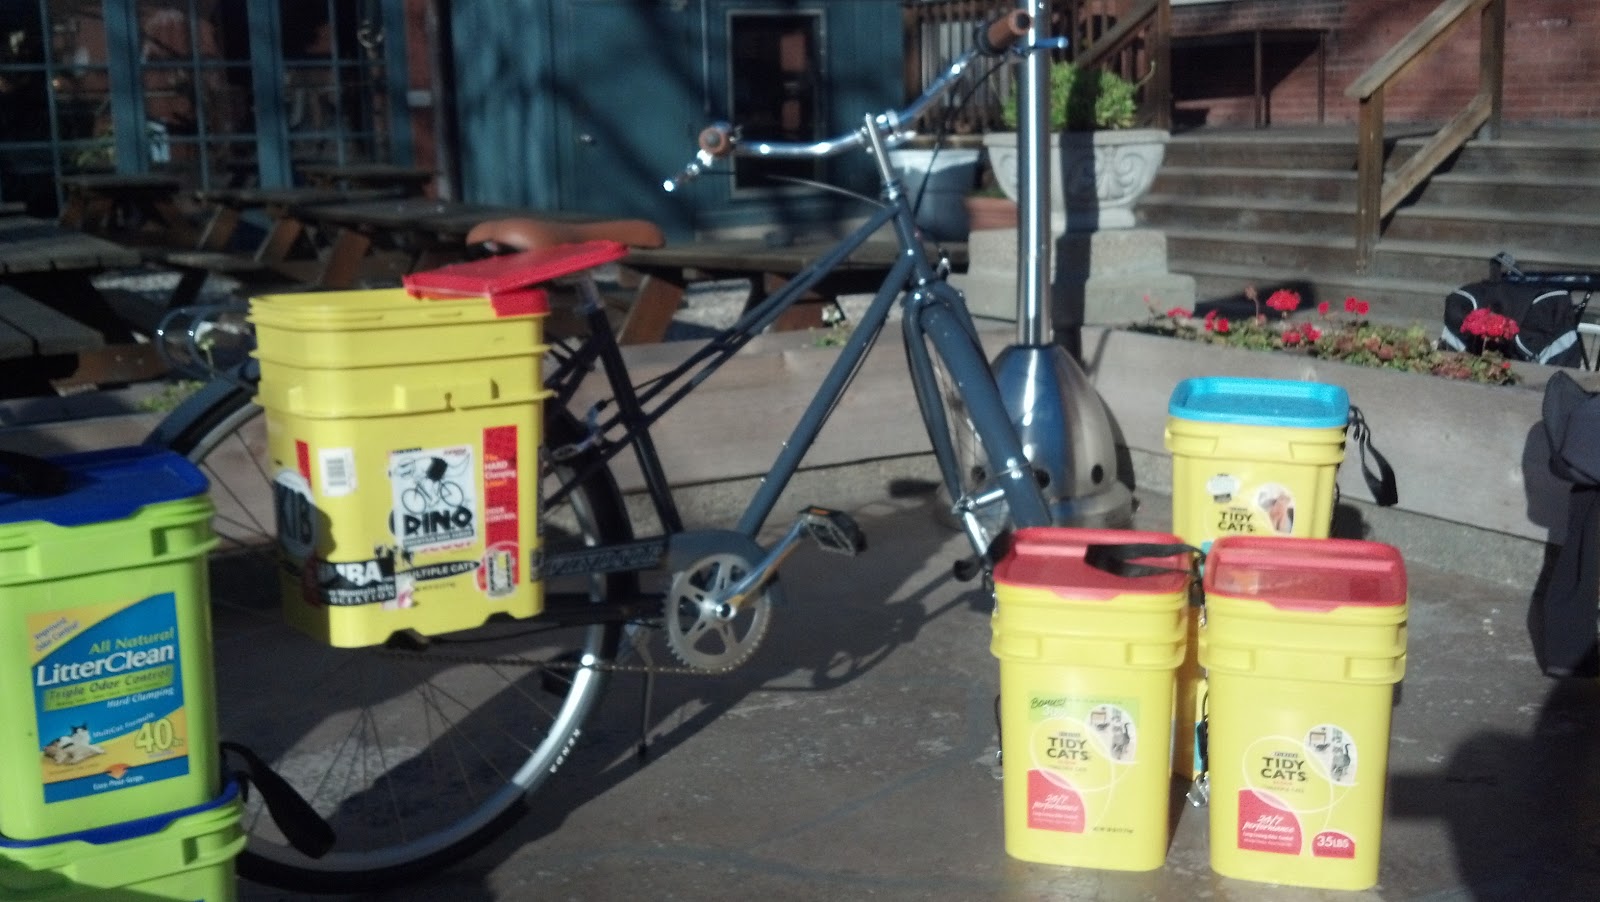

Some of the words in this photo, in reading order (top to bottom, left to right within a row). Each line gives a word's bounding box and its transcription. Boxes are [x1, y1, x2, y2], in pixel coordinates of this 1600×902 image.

[403, 505, 472, 535] DINO
[1219, 511, 1254, 522] TIDY
[1218, 521, 1254, 533] CATS
[450, 562, 475, 574] CATS
[89, 639, 111, 655] All
[115, 627, 175, 650] Natural
[36, 644, 175, 686] LitterClean
[48, 686, 85, 701] Triple
[89, 679, 120, 692] Odor
[124, 666, 172, 685] Control
[107, 696, 130, 708] Hard
[132, 687, 175, 703] Clumping
[135, 717, 173, 752] 40
[1047, 736, 1088, 750] TIDY
[549, 728, 581, 773] KENDA
[1046, 748, 1089, 761] CATS
[1262, 756, 1305, 770] TIDY
[1260, 768, 1306, 782] CATS
[1242, 821, 1295, 833] performance
[1257, 814, 1284, 826] 24/7
